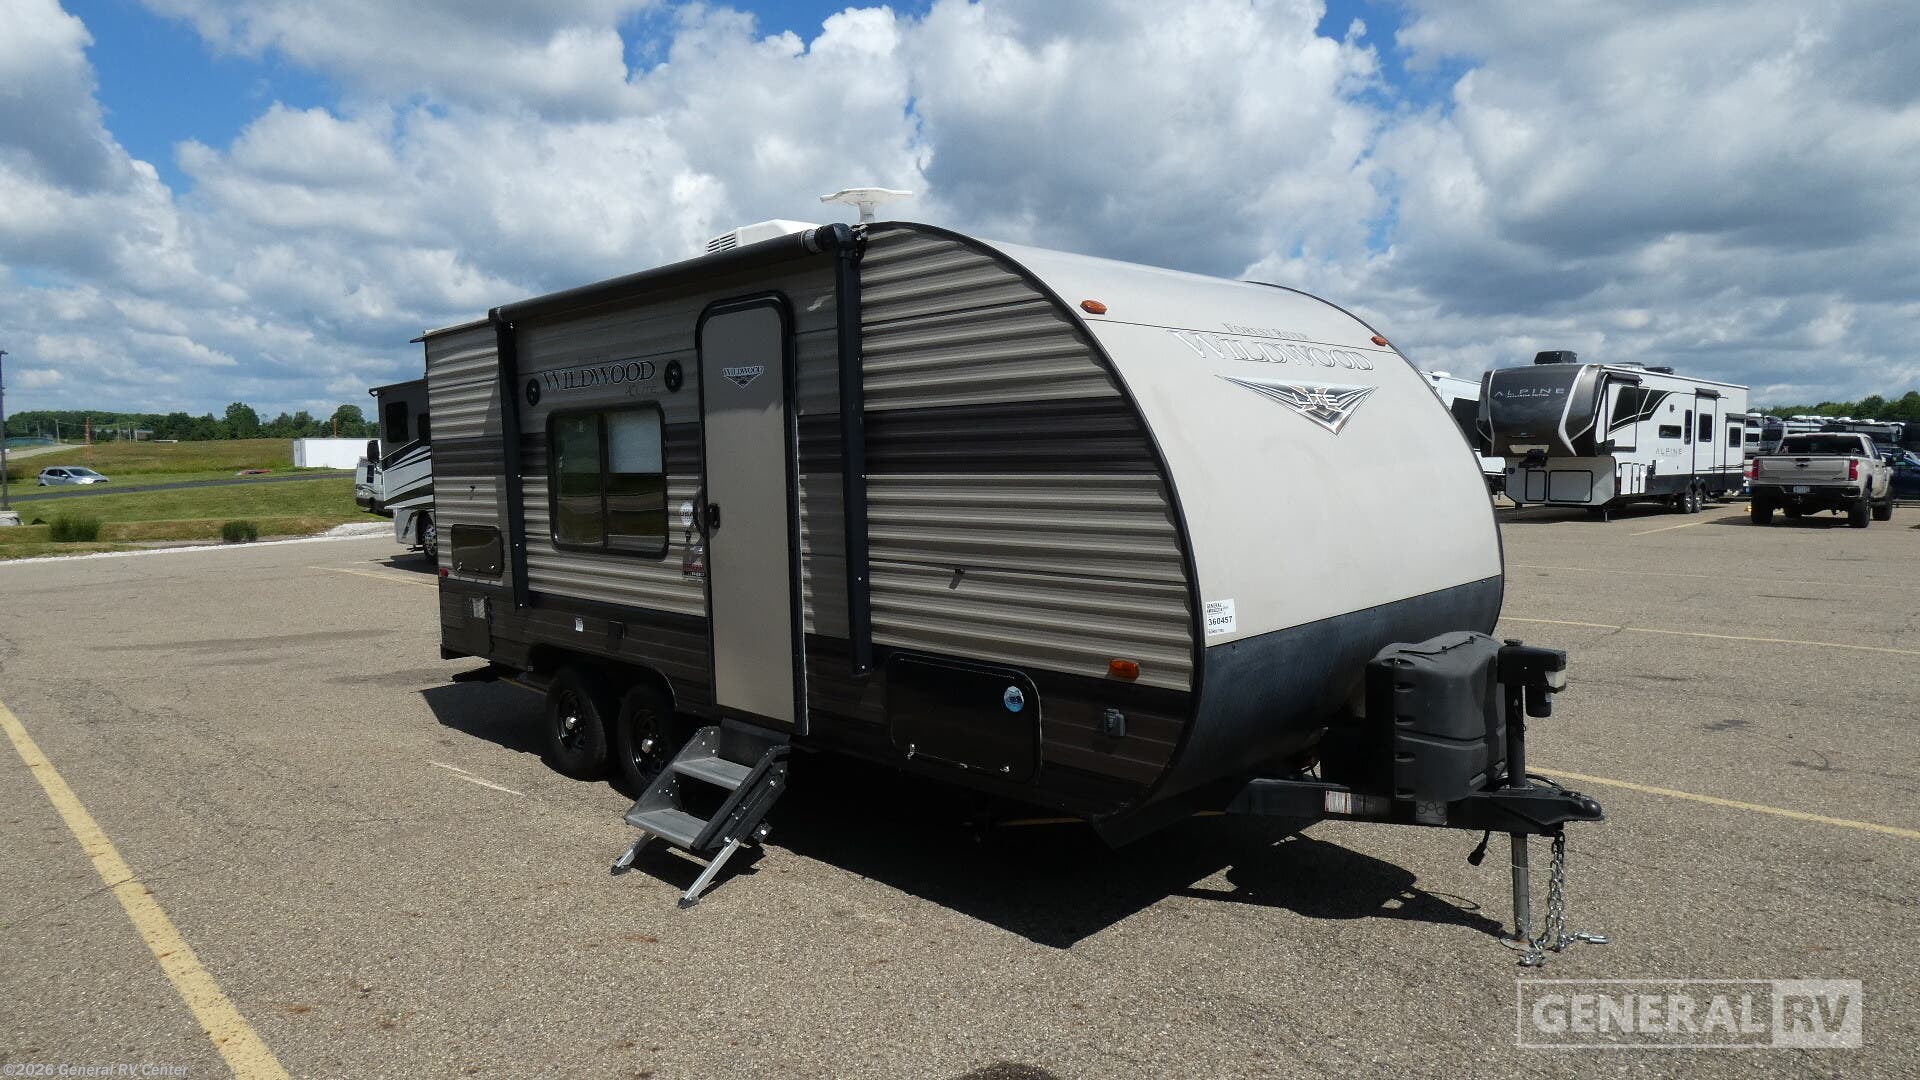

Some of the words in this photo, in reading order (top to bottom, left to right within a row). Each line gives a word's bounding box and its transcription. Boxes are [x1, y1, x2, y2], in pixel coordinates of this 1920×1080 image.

[1166, 328, 1374, 371] WILDWOOD
[542, 360, 656, 392] WILDWOOD
[1494, 387, 1565, 397] ALPINE
[1208, 616, 1232, 625] 360457
